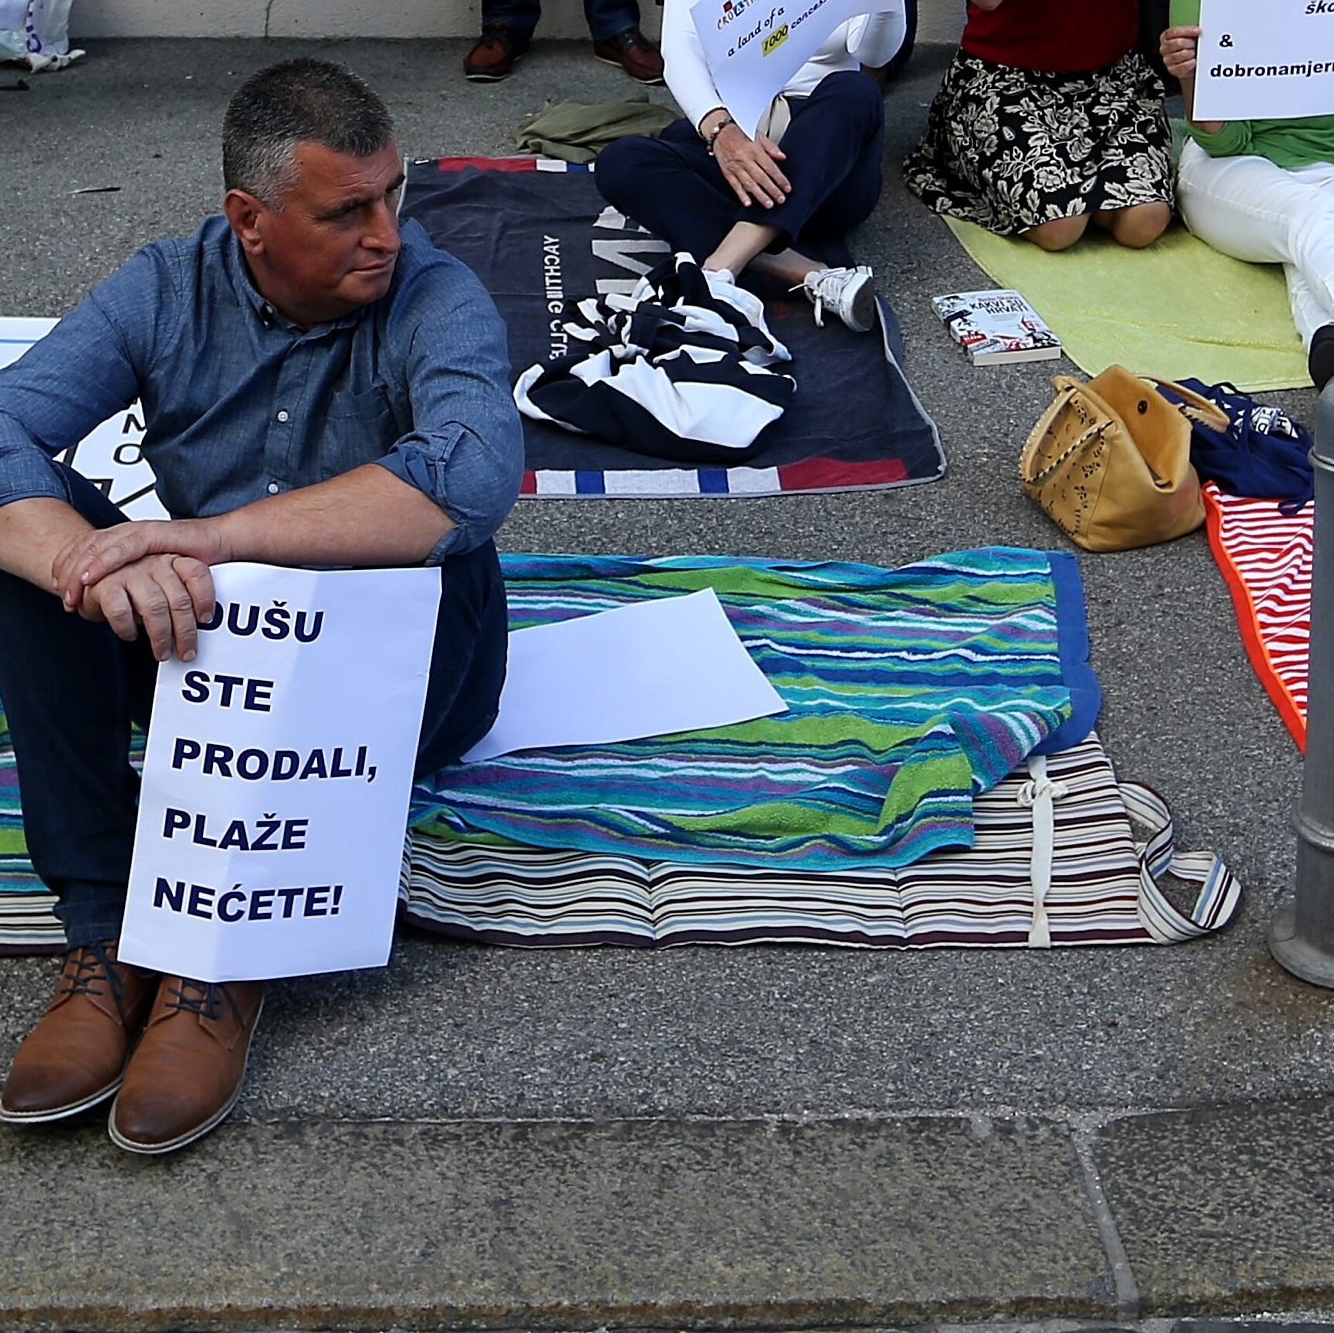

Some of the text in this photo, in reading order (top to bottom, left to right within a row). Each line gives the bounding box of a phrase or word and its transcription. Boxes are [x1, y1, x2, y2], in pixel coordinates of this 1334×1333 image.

[727, 6, 785, 57] a land of a
[763, 24, 789, 51] 1000
[1219, 34, 1234, 48] &
[181, 670, 274, 712] STE
[172, 737, 378, 783] PRODALI,
[162, 807, 310, 851] PLAŽE
[153, 876, 344, 924] NEĆETE!
